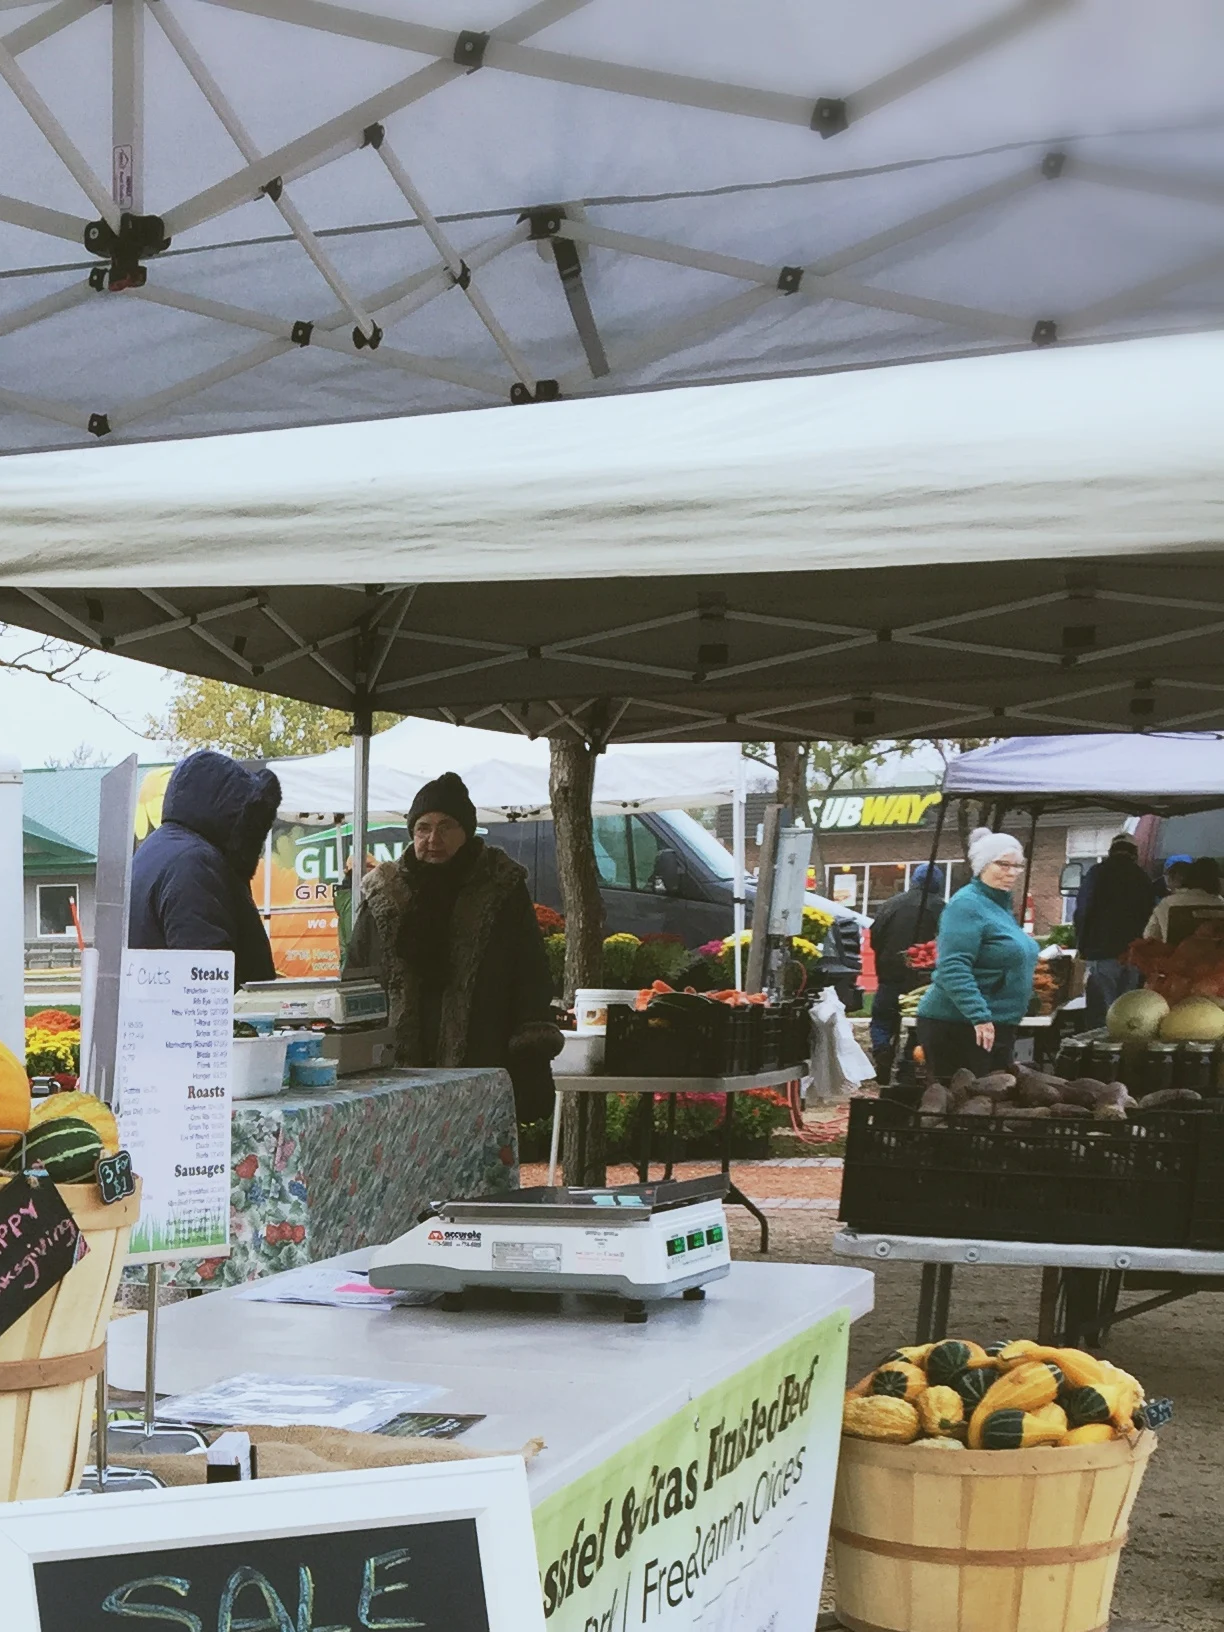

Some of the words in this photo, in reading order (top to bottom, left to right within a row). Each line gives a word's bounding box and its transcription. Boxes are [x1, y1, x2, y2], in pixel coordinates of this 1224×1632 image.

[191, 967, 229, 981] Steaks
[188, 1086, 225, 1099] Roasts
[102, 1165, 114, 1184] 3
[175, 1164, 225, 1178] Sausages
